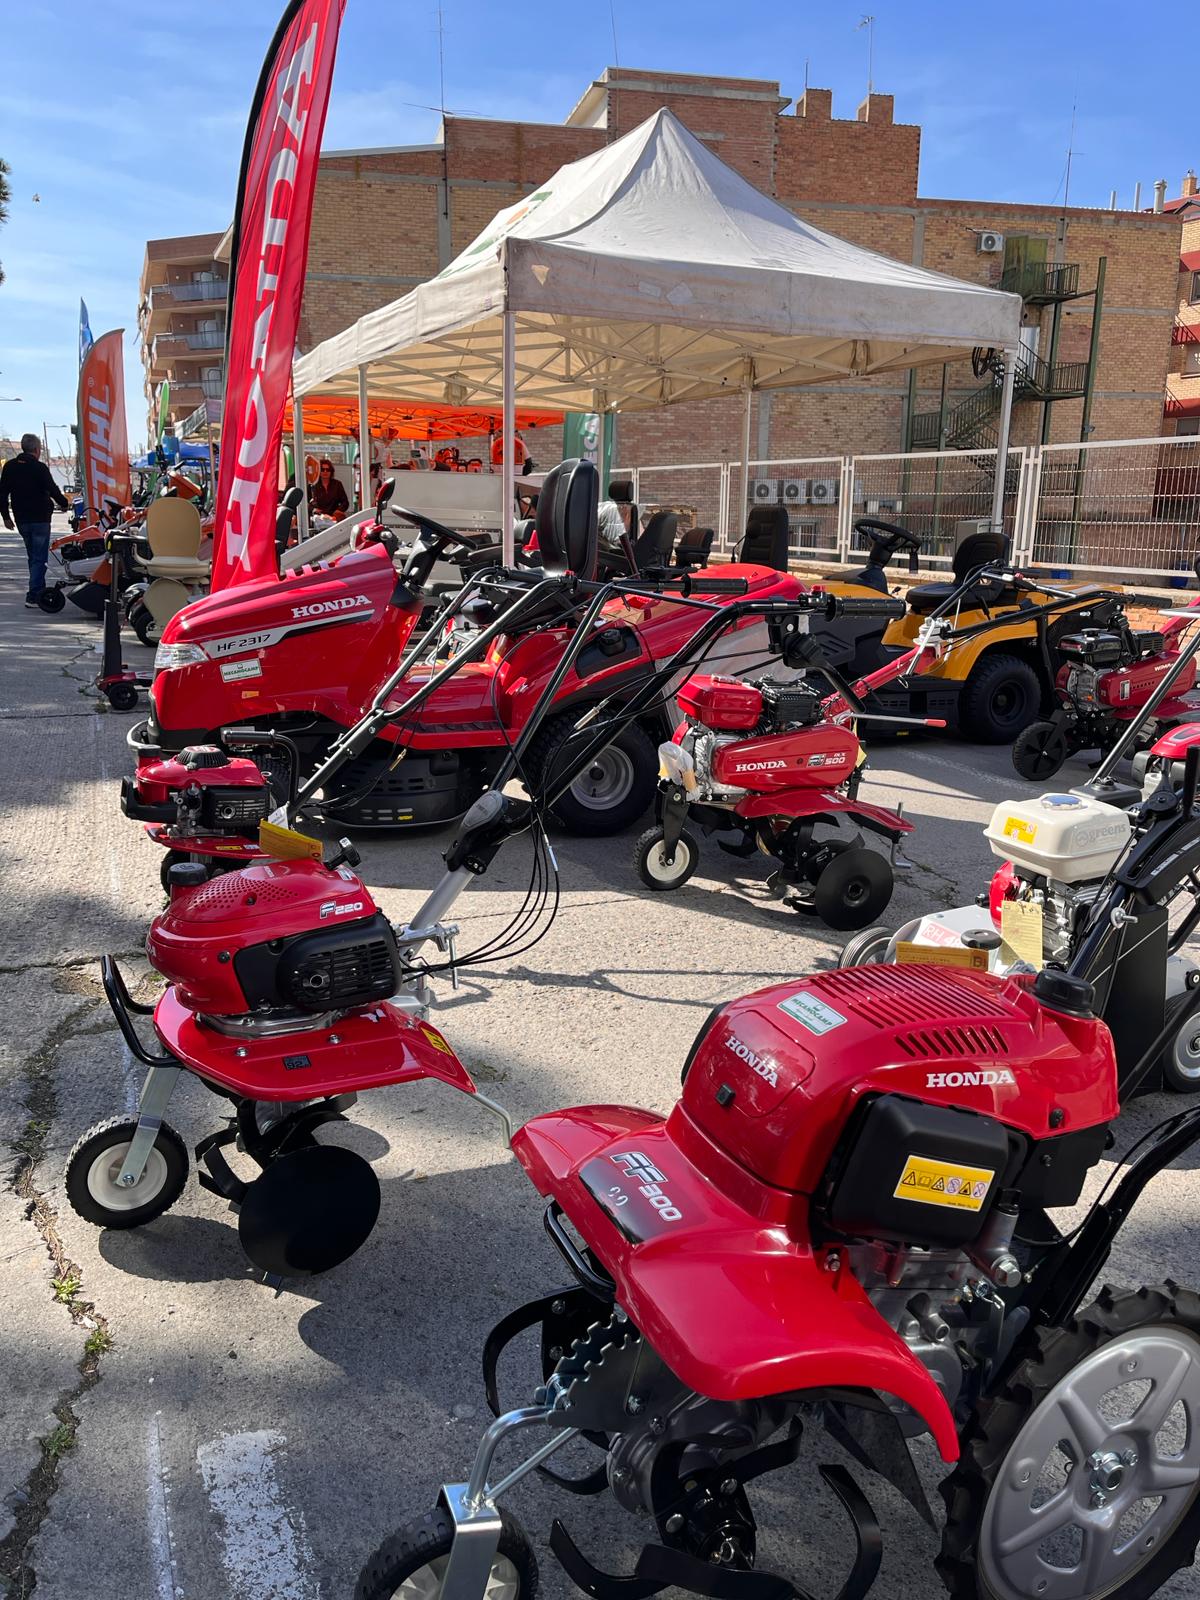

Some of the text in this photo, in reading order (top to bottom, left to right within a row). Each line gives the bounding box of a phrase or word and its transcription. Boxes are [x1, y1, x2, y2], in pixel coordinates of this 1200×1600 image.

[226, 22, 318, 572] HONDA
[291, 594, 372, 619] HONDA
[217, 634, 271, 652] HF 2317
[735, 760, 787, 772] HONDA
[1088, 823, 1126, 843] greens
[320, 901, 363, 919] F220
[725, 1035, 778, 1088] HONDA
[925, 1070, 1016, 1088] HONDA
